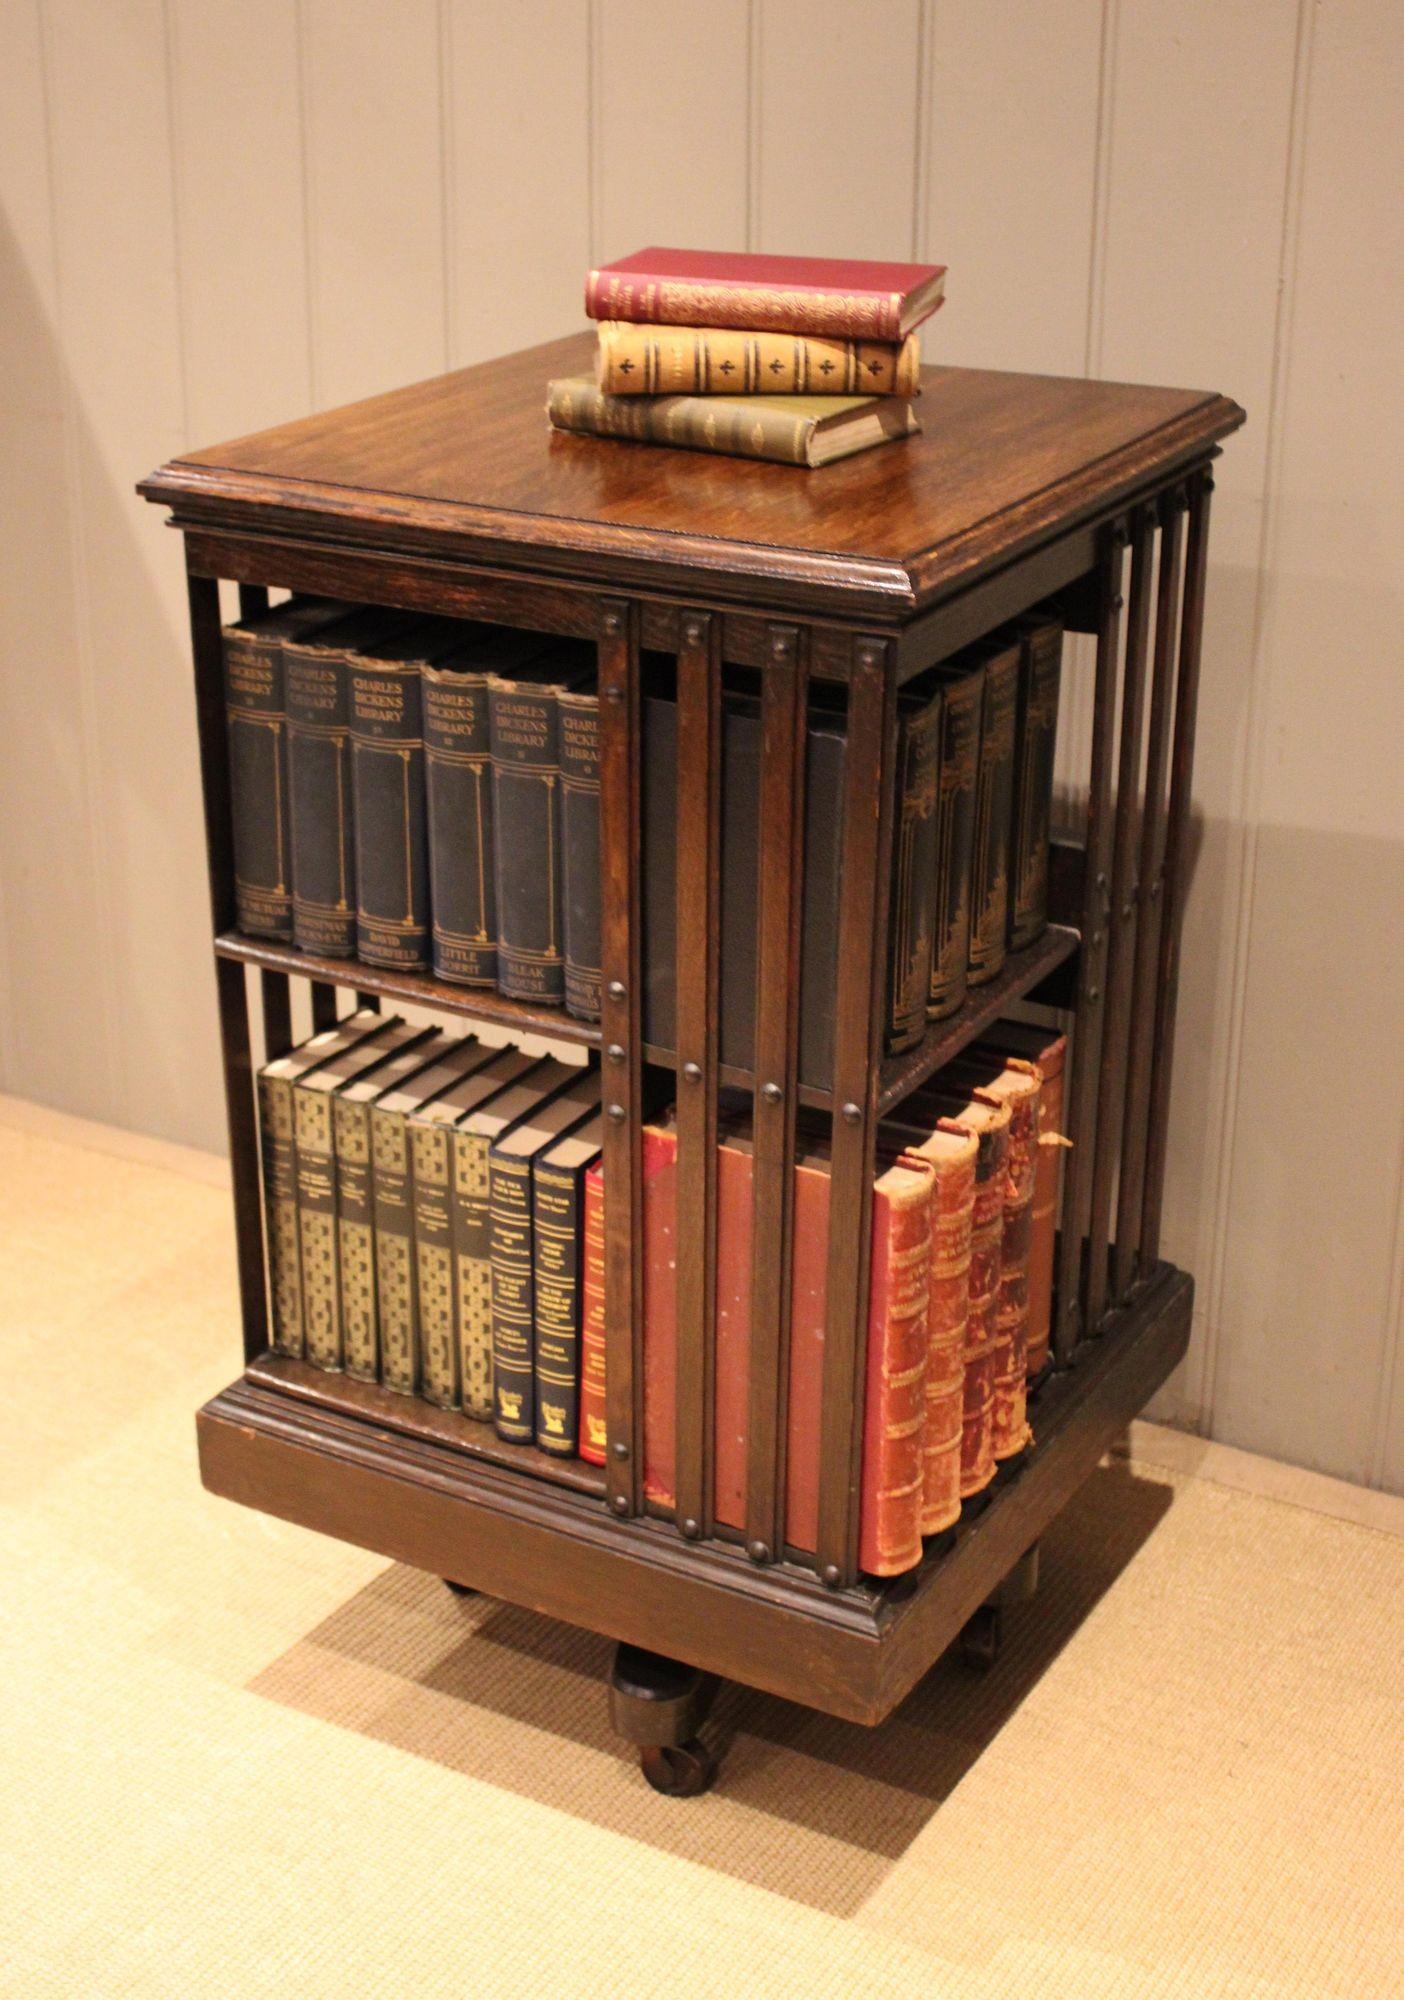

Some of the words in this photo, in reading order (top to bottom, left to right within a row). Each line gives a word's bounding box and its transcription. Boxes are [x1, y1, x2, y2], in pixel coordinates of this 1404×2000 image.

[353, 677, 403, 694] CHARLES
[354, 691, 404, 709] DICKENS
[426, 691, 474, 707] CHARLES
[355, 705, 403, 722] LIBRARY
[427, 703, 475, 721] DICKENS
[495, 702, 547, 718] CHARLES
[428, 719, 475, 736] LIBRARY
[496, 716, 548, 733] DICKENS
[563, 717, 598, 732] CHARL
[498, 731, 548, 747] LIBRARY
[564, 732, 599, 747] DICKE
[565, 746, 599, 762] LIBRA
[369, 932, 400, 947] DAVID
[440, 946, 478, 963] LITTLE
[439, 959, 480, 975] DORRIT
[507, 962, 545, 978] BLEAK
[508, 976, 545, 991] HOUSE
